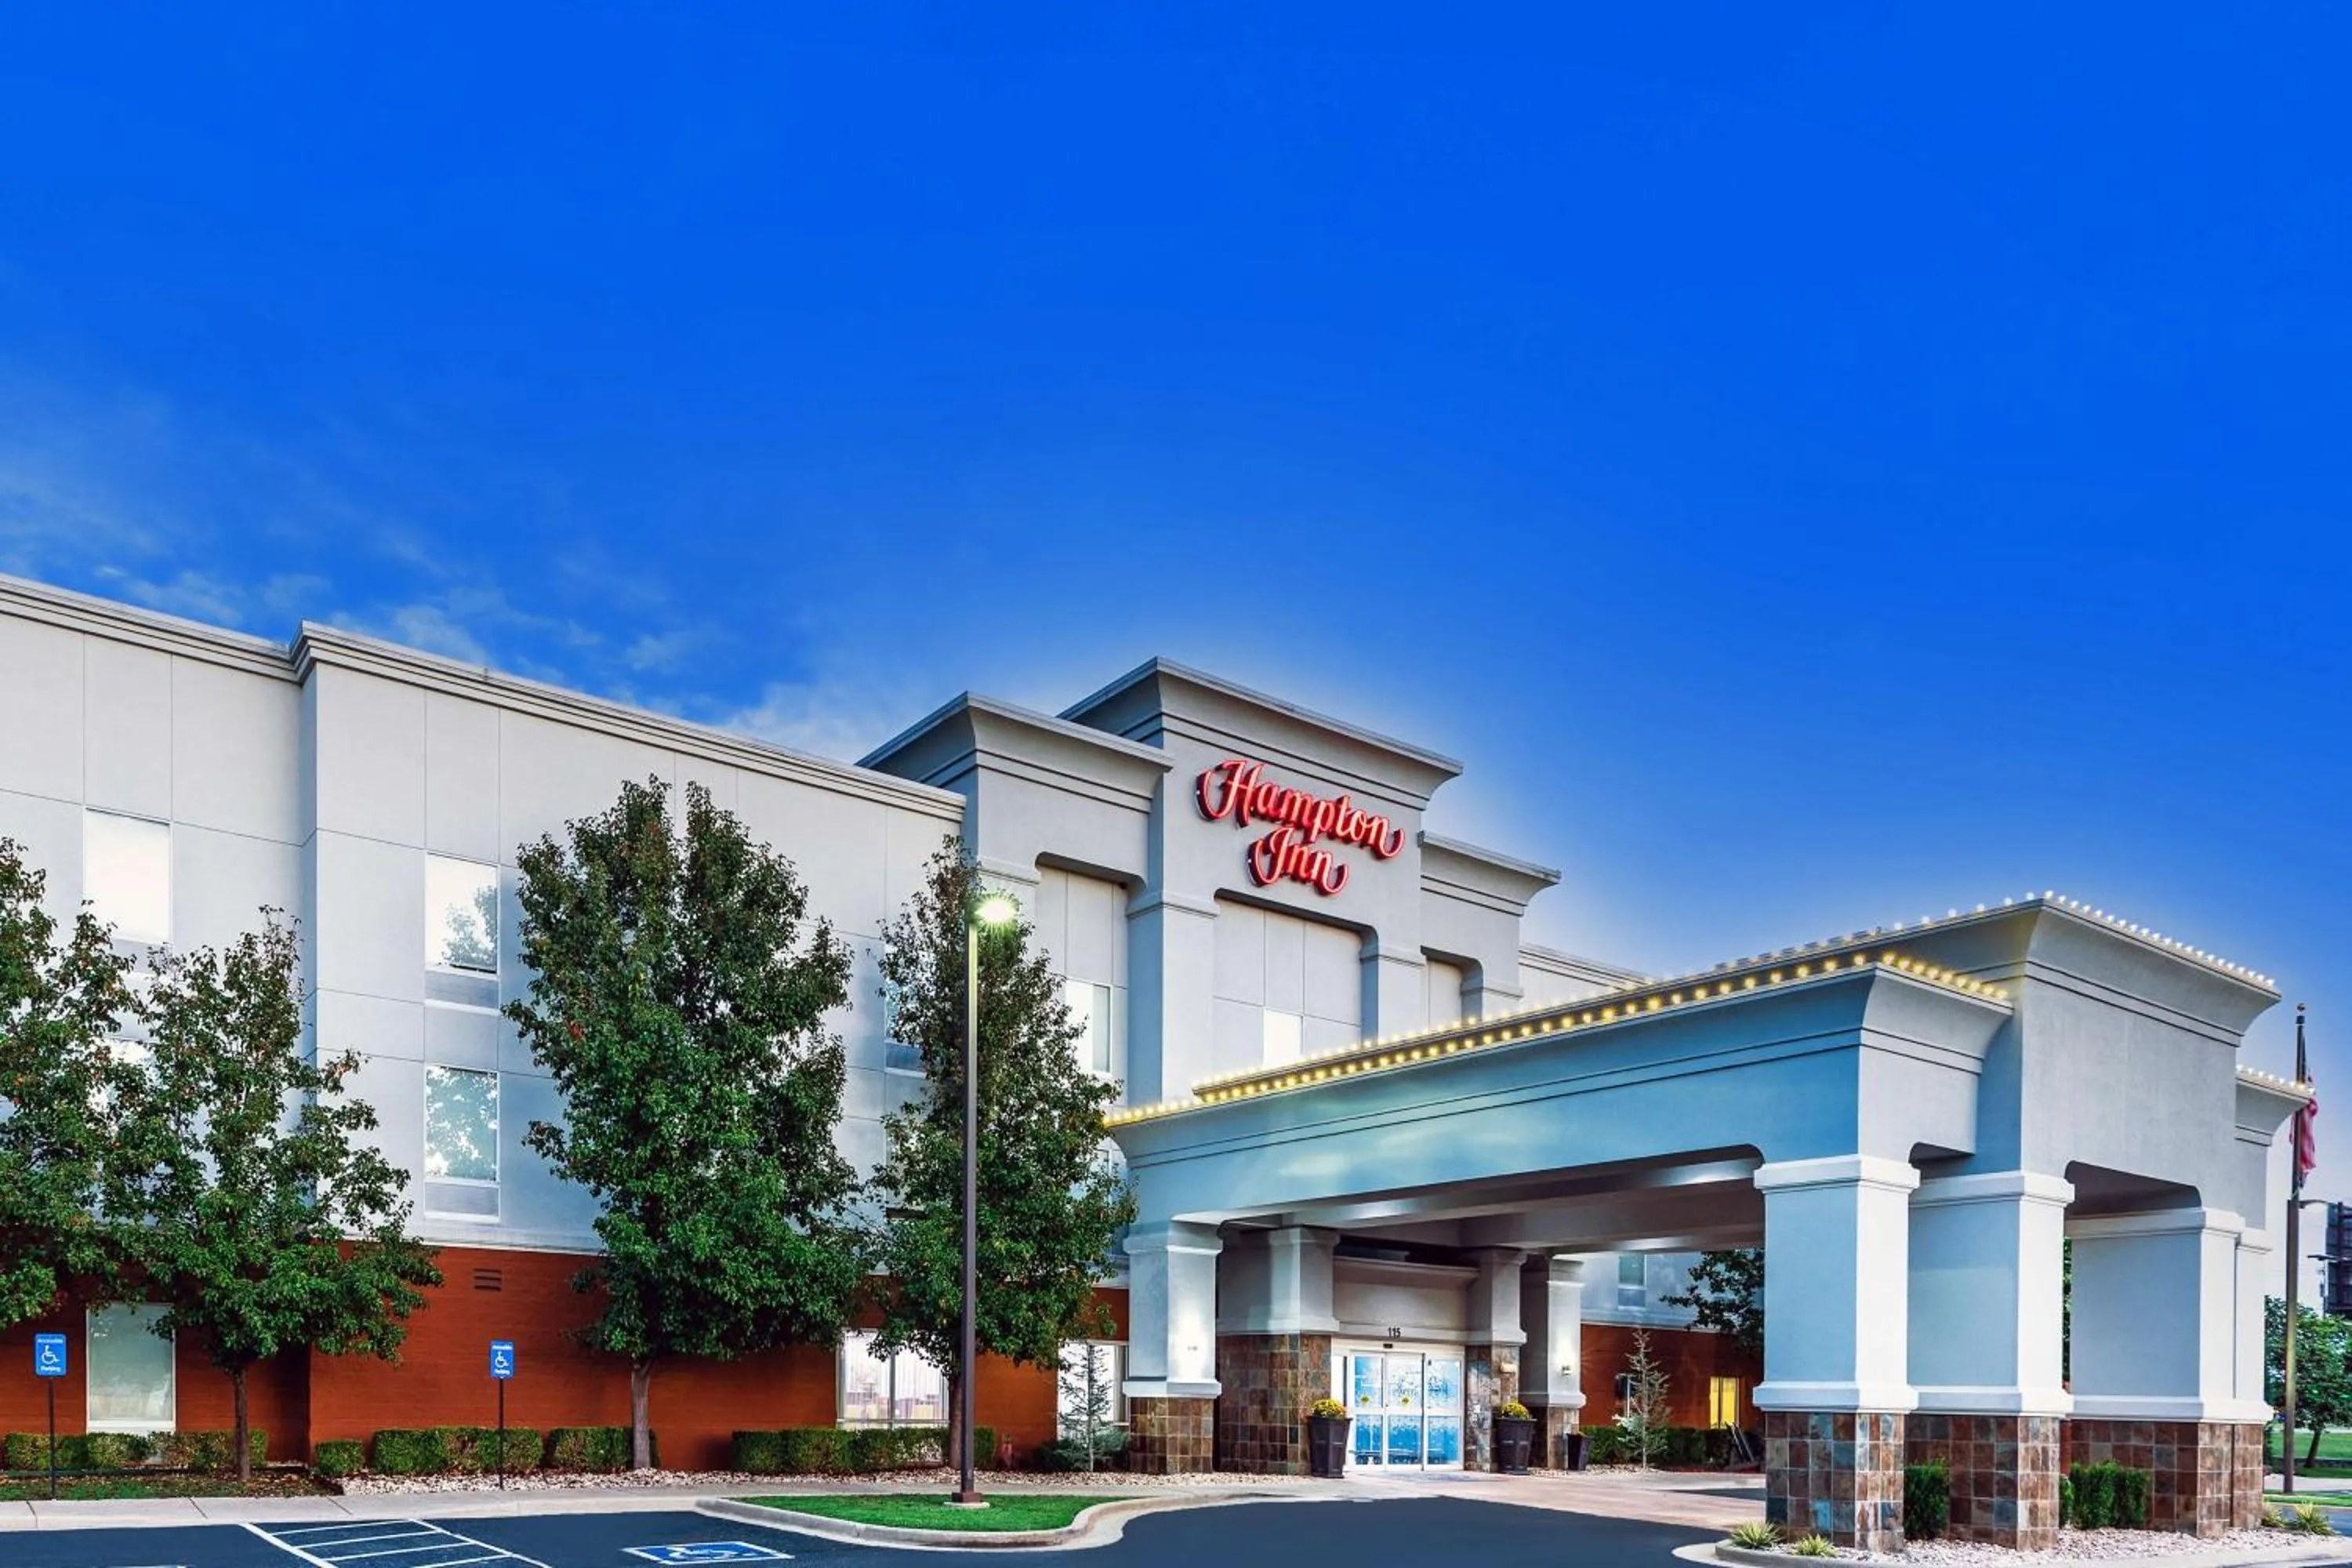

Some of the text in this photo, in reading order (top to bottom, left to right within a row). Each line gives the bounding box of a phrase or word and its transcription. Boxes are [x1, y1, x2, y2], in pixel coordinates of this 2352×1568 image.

[1196, 760, 1405, 859] Hampton
[1248, 826, 1348, 895] Inn
[1387, 1327, 1401, 1338] 115
